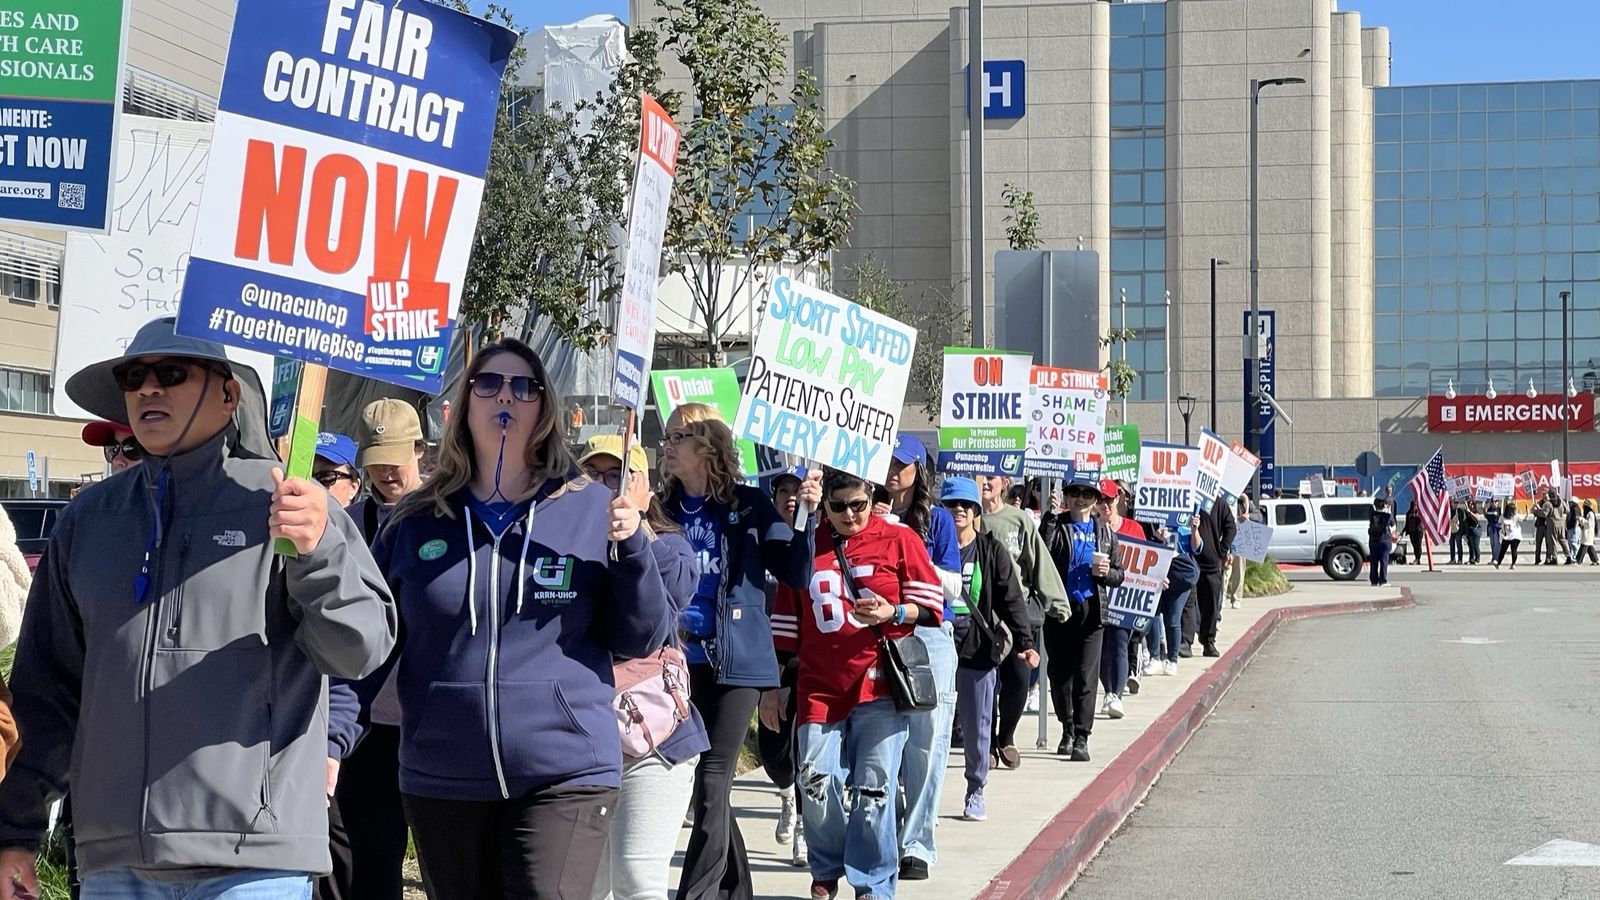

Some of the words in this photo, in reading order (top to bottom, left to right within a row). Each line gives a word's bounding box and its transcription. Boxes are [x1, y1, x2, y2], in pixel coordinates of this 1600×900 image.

[30, 13, 79, 31] AND
[0, 35, 19, 52] H
[25, 37, 83, 56] CARE
[321, 0, 433, 80] FAIR
[0, 60, 94, 81] SIONALS
[263, 51, 464, 148] CONTRACT
[983, 72, 1011, 107] H
[0, 108, 52, 128] NENTE:
[27, 136, 87, 170] NOW
[234, 138, 459, 280] NOW
[241, 283, 348, 326] @unacuhcp
[370, 281, 409, 312] ULP
[371, 308, 440, 342] STRIKE
[770, 276, 840, 336] SHORT
[840, 303, 911, 366] STAFFED
[776, 323, 832, 377] LOW
[838, 345, 884, 396] PAY
[973, 356, 1004, 387] ON
[668, 377, 714, 400] Unfair
[1037, 371, 1058, 388] ULP
[1061, 372, 1100, 389] STRIKE
[1259, 356, 1271, 415] HOSPIT
[745, 355, 833, 422] PATIENTS
[836, 387, 894, 446] SUFFER
[952, 392, 1022, 420] STRIKE
[1042, 394, 1097, 413] SHAME
[1465, 404, 1583, 421] EMERGENCY
[970, 428, 977, 436] To
[977, 428, 998, 436] Protect
[1052, 412, 1076, 427] ON
[742, 398, 829, 459] EVERY
[831, 428, 881, 480] DAY
[952, 438, 967, 449] Our
[968, 437, 1017, 449] Professions
[1039, 426, 1096, 446] KAISER
[1104, 430, 1124, 441] nfair
[955, 452, 989, 463] @unacuhcp
[1076, 453, 1088, 462] ULP
[1105, 443, 1125, 454] abor
[1107, 454, 1137, 466] ractice
[1203, 438, 1224, 466] ULP
[1076, 461, 1100, 472] STRIKE
[1152, 451, 1189, 476] ULP
[1196, 470, 1219, 497] TRIKE
[1138, 487, 1191, 508] STRIKE
[1120, 543, 1158, 575] ULP
[1108, 586, 1155, 612] TRIKE
